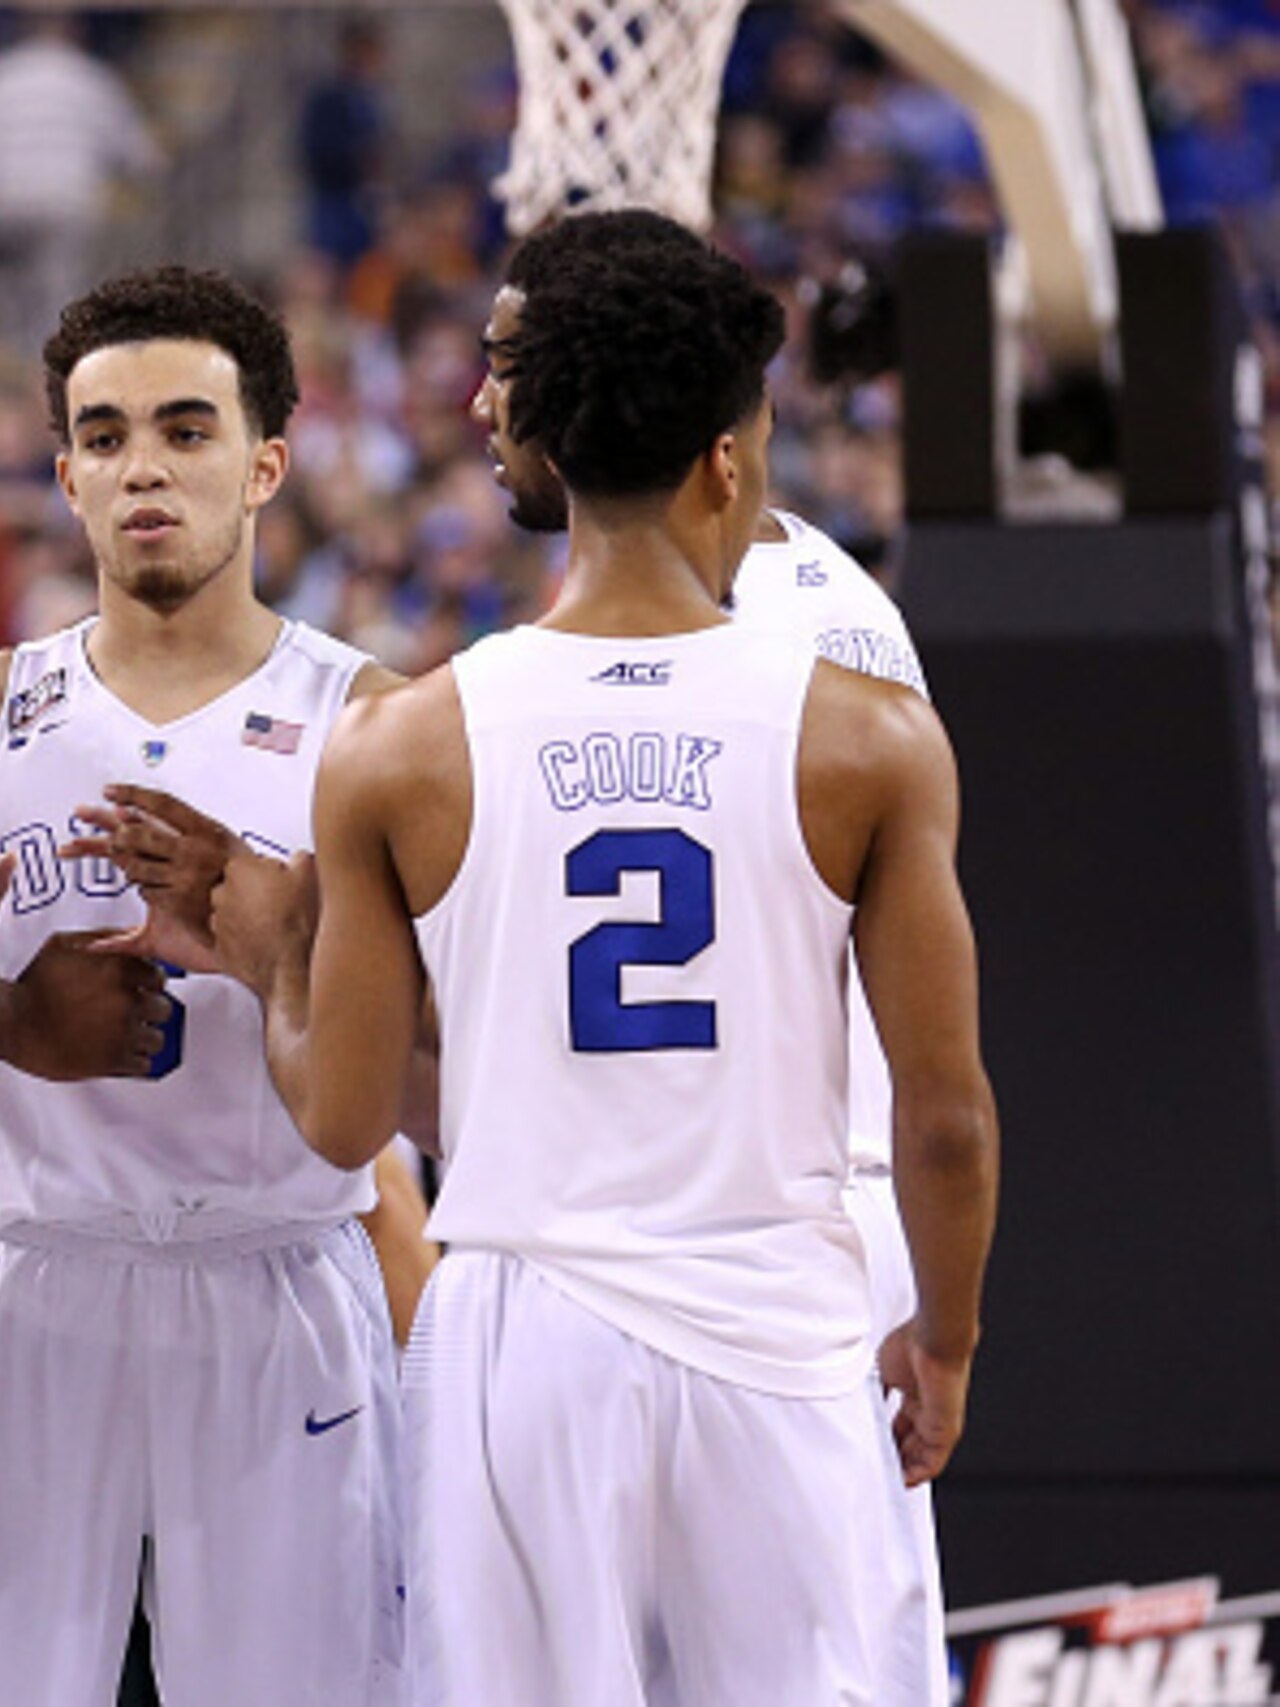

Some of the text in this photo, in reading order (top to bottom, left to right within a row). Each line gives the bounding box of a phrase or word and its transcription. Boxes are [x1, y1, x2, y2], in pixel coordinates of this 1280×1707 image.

[586, 658, 675, 687] ACC
[539, 731, 723, 812] COOK
[564, 827, 718, 1053] 2
